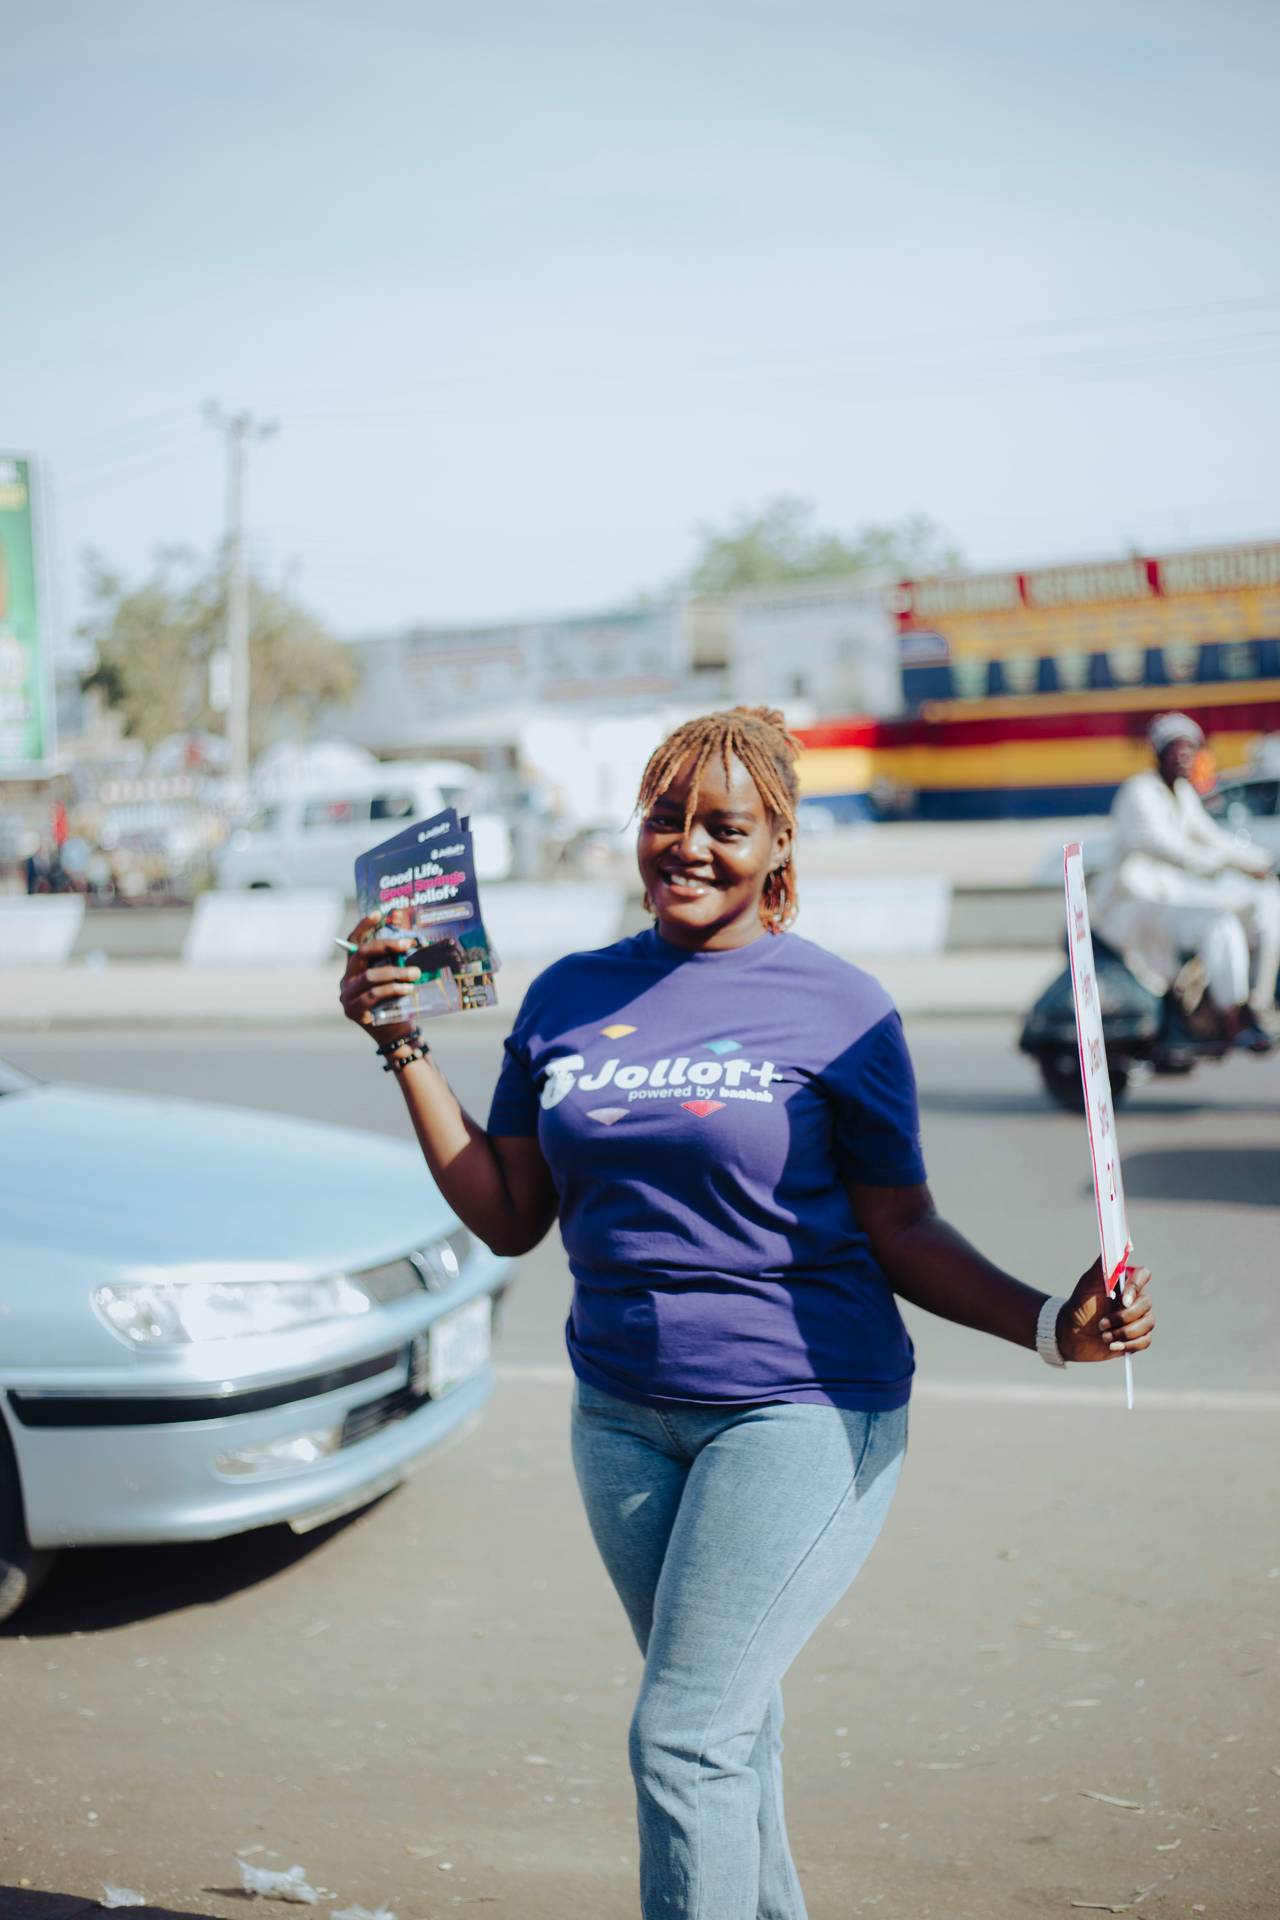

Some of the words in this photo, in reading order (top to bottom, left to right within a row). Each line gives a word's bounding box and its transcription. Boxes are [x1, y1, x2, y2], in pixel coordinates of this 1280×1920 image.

[379, 867, 413, 889] Good
[414, 862, 444, 880] Life,
[379, 883, 413, 902] Good
[415, 871, 466, 892] Savings
[380, 895, 409, 914] with
[410, 884, 459, 906] Jollof+
[628, 1085, 692, 1102] powered
[696, 1086, 715, 1100] by
